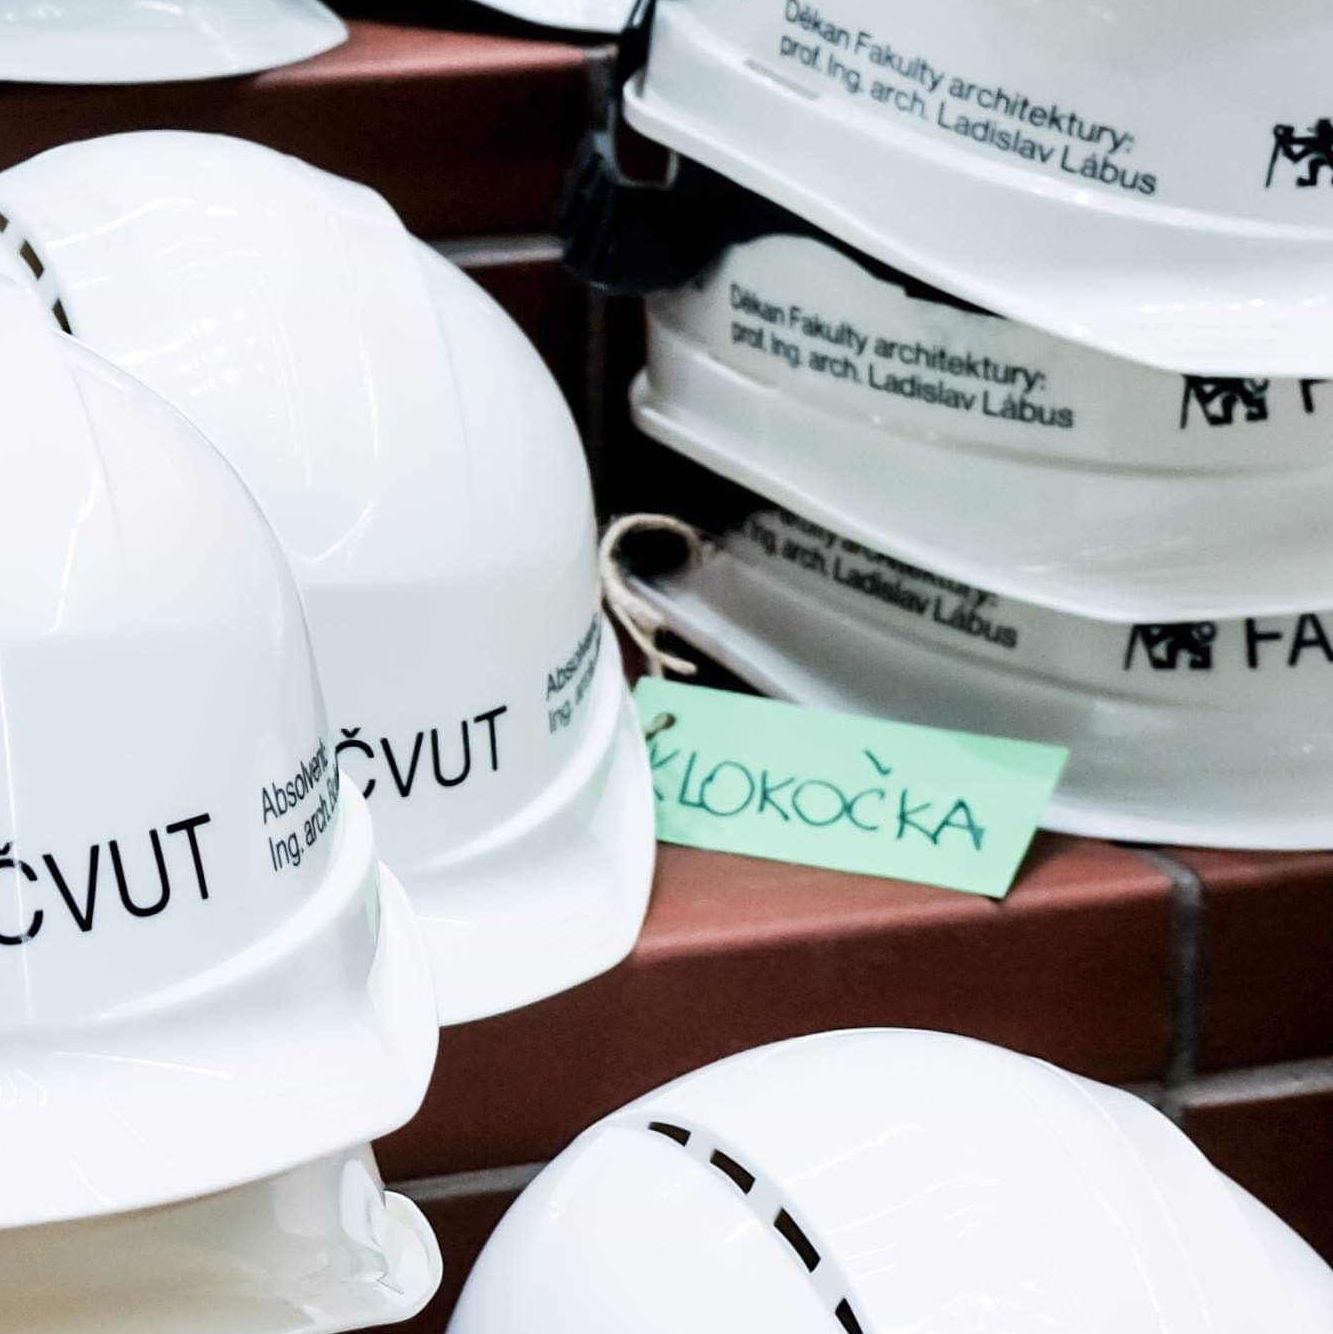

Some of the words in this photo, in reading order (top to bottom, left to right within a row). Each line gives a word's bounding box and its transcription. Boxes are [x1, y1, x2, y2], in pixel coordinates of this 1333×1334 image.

[854, 30, 946, 93] Fakulty
[948, 75, 1137, 155] architektury:
[937, 101, 1055, 164] Ladislav
[1060, 144, 1158, 196] Lábus
[789, 305, 869, 357] Fakulty
[874, 334, 1048, 394] architektury:
[868, 363, 977, 414] Ladislav
[982, 389, 1075, 430] Lábus
[334, 704, 508, 801] ČVUT
[268, 826, 305, 872] Ing.
